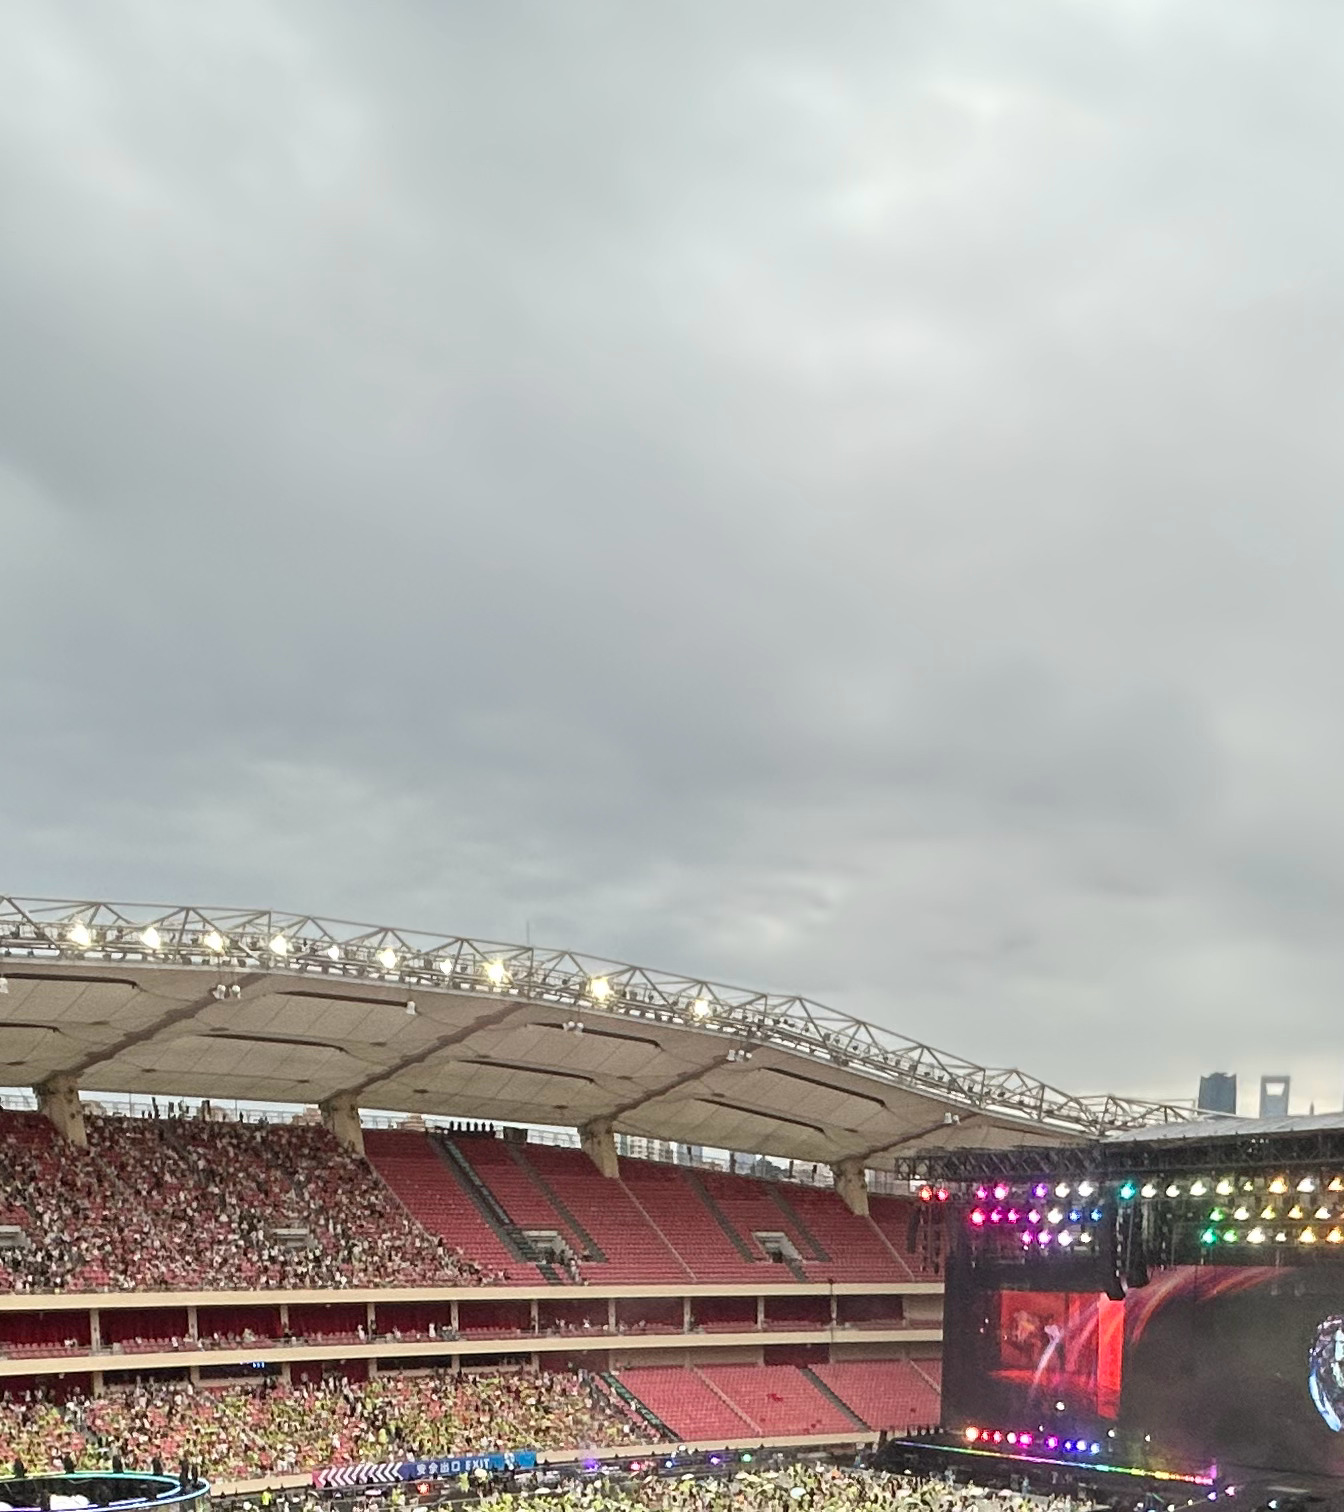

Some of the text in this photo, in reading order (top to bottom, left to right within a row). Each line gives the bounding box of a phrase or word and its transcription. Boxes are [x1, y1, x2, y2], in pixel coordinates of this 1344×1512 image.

[416, 1458, 490, 1476] 安全出口 EXIT
